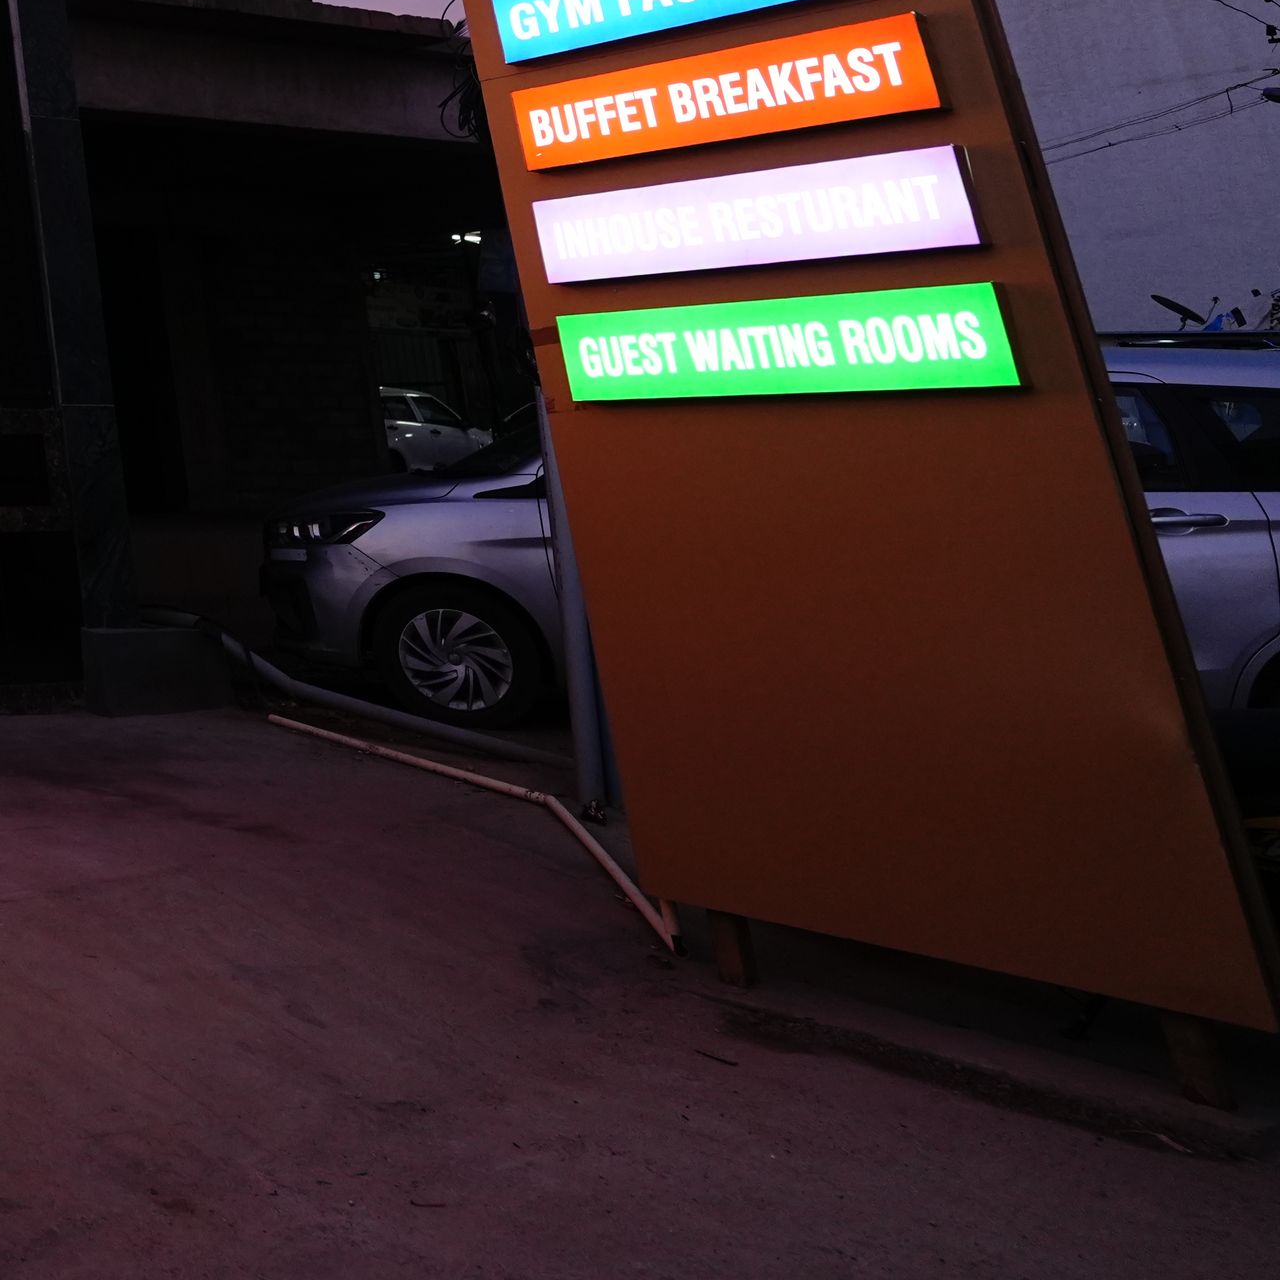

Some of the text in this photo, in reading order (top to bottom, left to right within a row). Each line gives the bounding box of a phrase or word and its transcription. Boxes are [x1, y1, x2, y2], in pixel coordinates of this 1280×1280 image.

[528, 42, 903, 147] BUFFET BREAKFAST
[554, 203, 703, 261] INHOUSE
[578, 311, 987, 379] GUEST WAITING ROOMS
